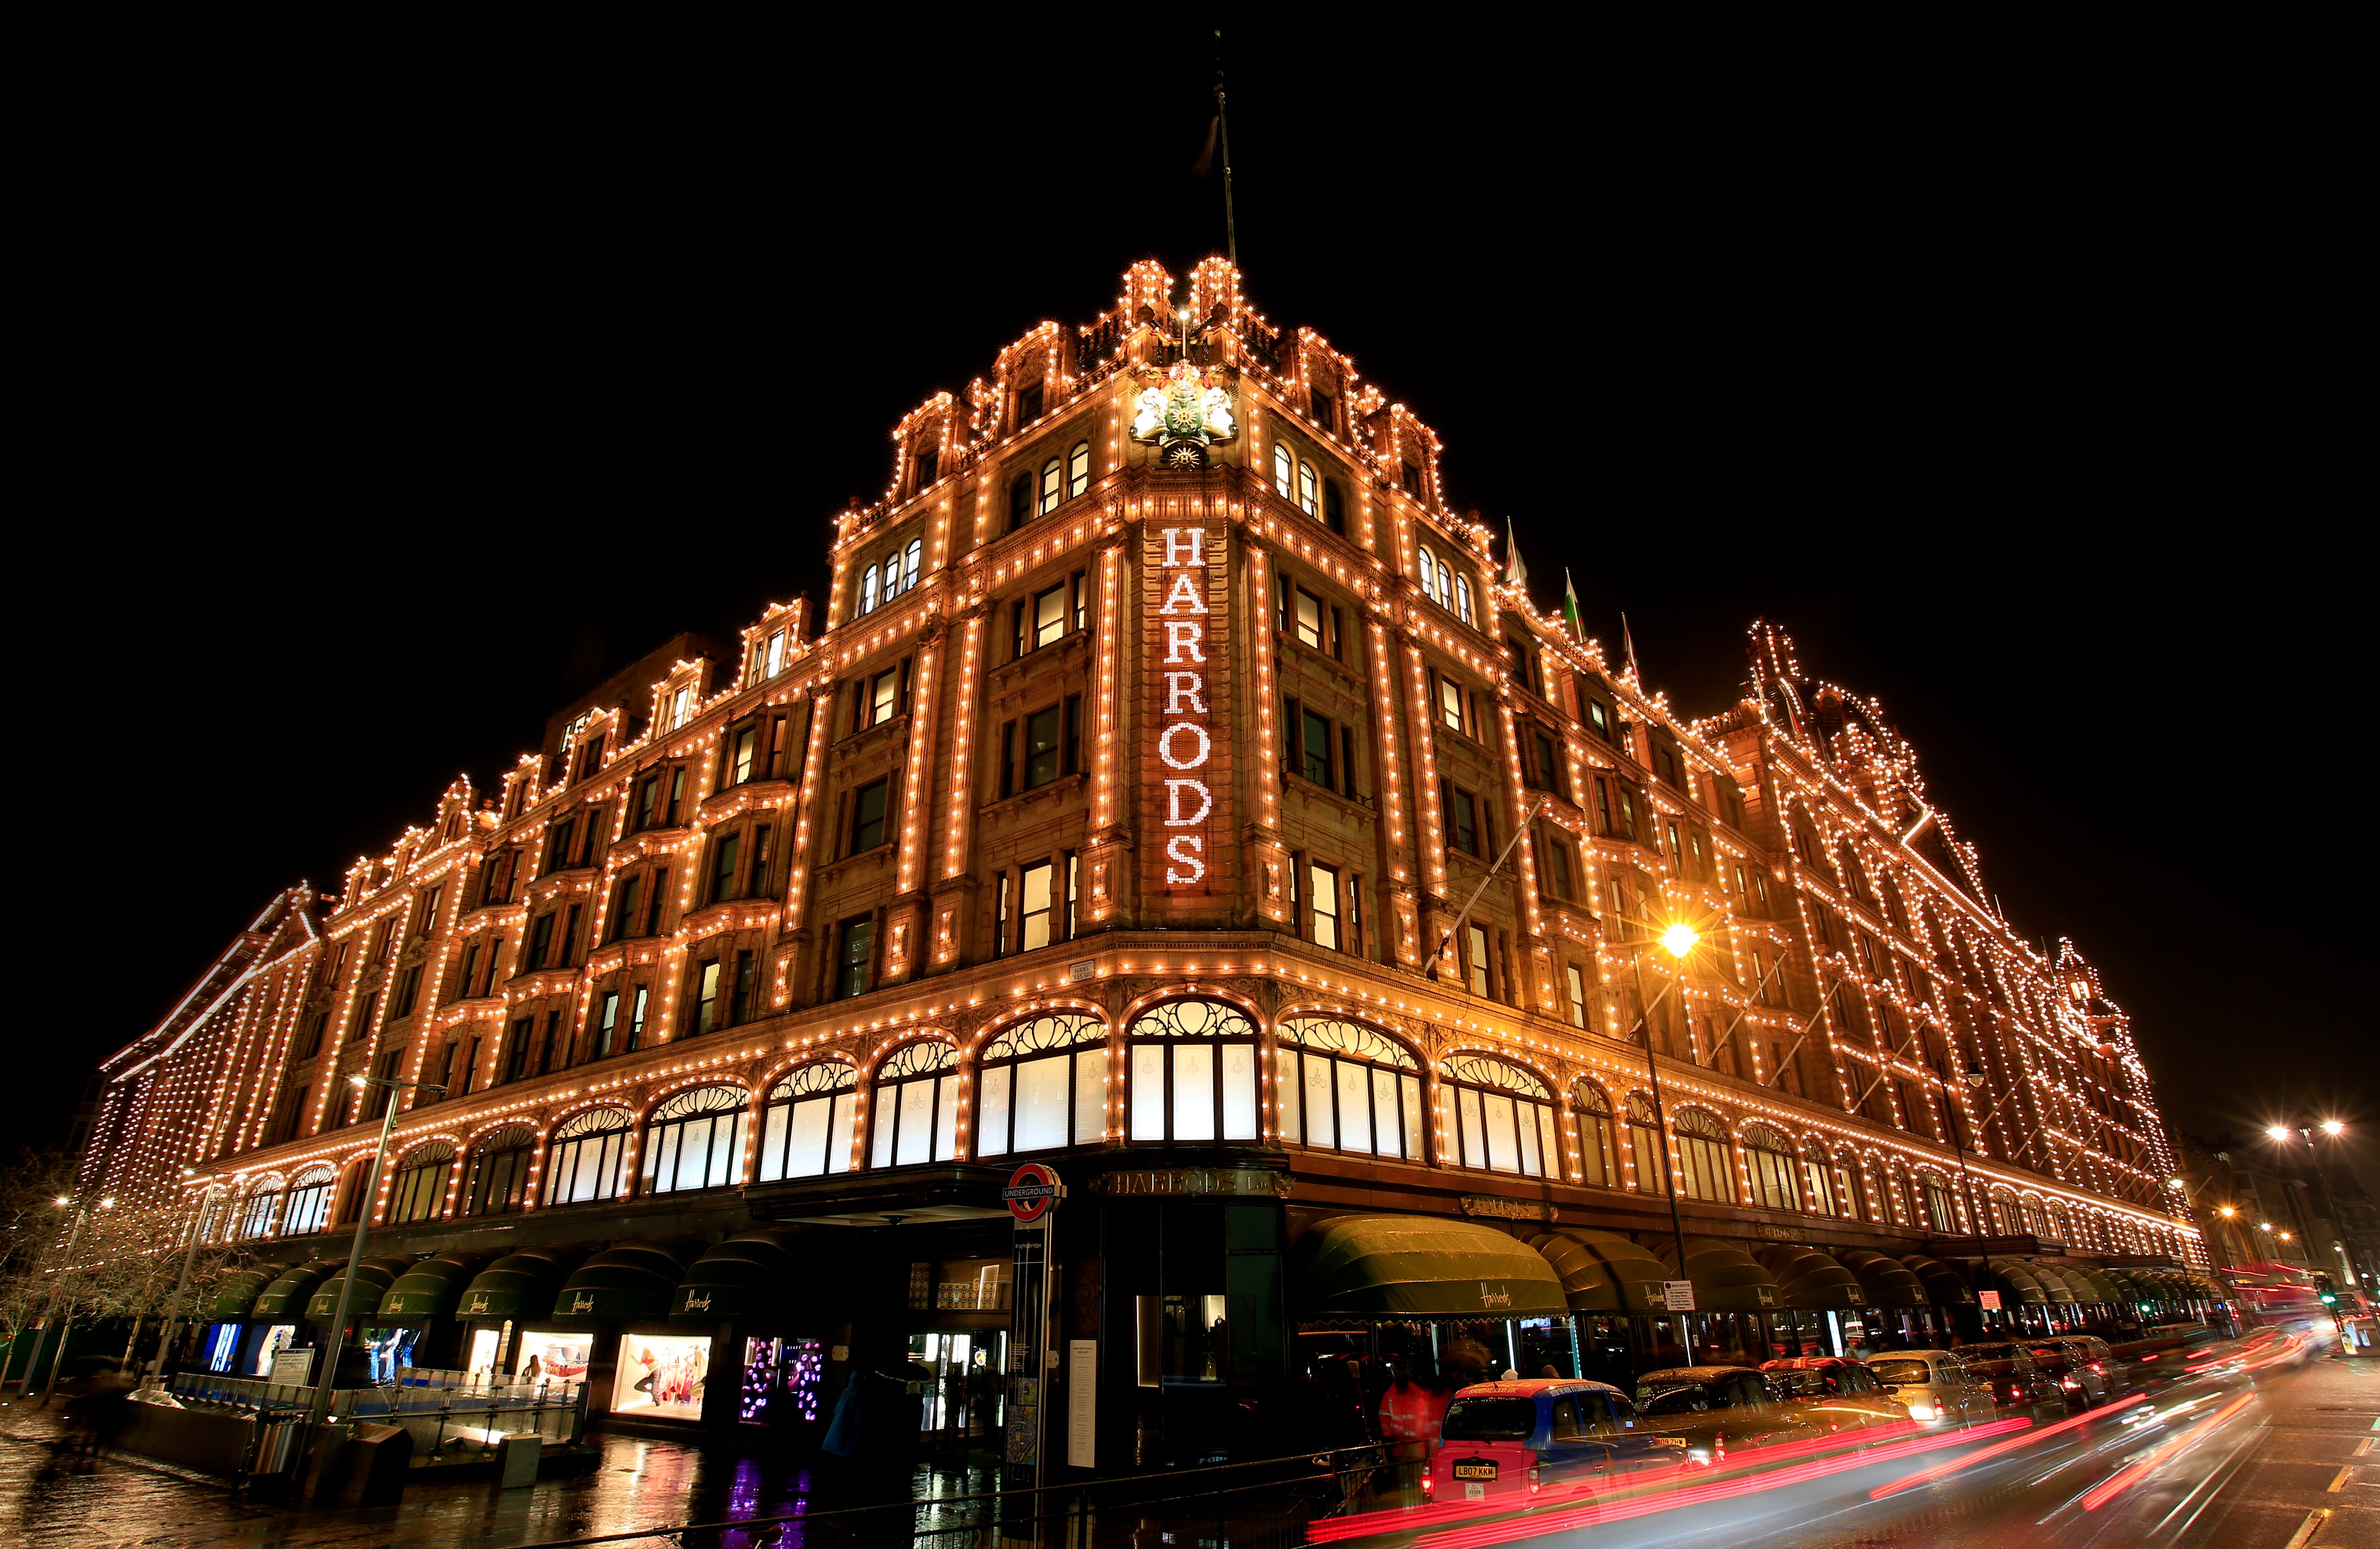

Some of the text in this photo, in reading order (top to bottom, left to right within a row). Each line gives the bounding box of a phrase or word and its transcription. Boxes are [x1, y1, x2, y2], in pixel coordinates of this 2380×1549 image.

[1159, 528, 1212, 885] HARRODS
[1075, 965, 1089, 974] HANS
[1005, 1187, 1053, 1197] UNDERGROUND
[1116, 1172, 1236, 1193] HARRODS
[684, 1289, 712, 1312] Harrods
[1480, 1282, 1511, 1308] Harrods
[1645, 1285, 1666, 1306] Harrods
[1459, 1467, 1477, 1475] LB07
